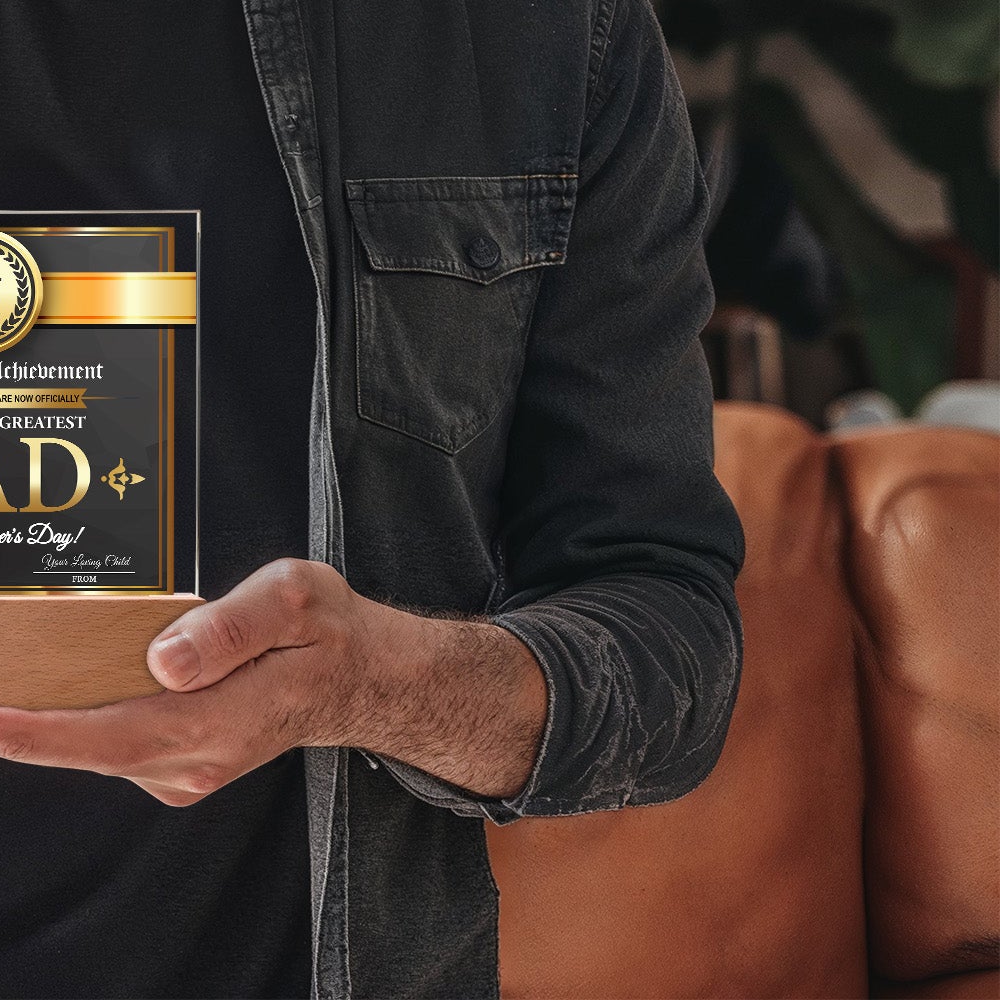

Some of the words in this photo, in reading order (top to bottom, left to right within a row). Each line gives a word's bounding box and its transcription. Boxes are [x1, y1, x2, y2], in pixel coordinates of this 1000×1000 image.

[14, 394, 34, 403] NOW
[34, 394, 80, 403] OFFICIALLY
[26, 521, 86, 552] Day!
[41, 553, 68, 571] Your
[70, 553, 102, 570] Loving
[104, 554, 132, 567] Child
[72, 575, 97, 583] FROM
